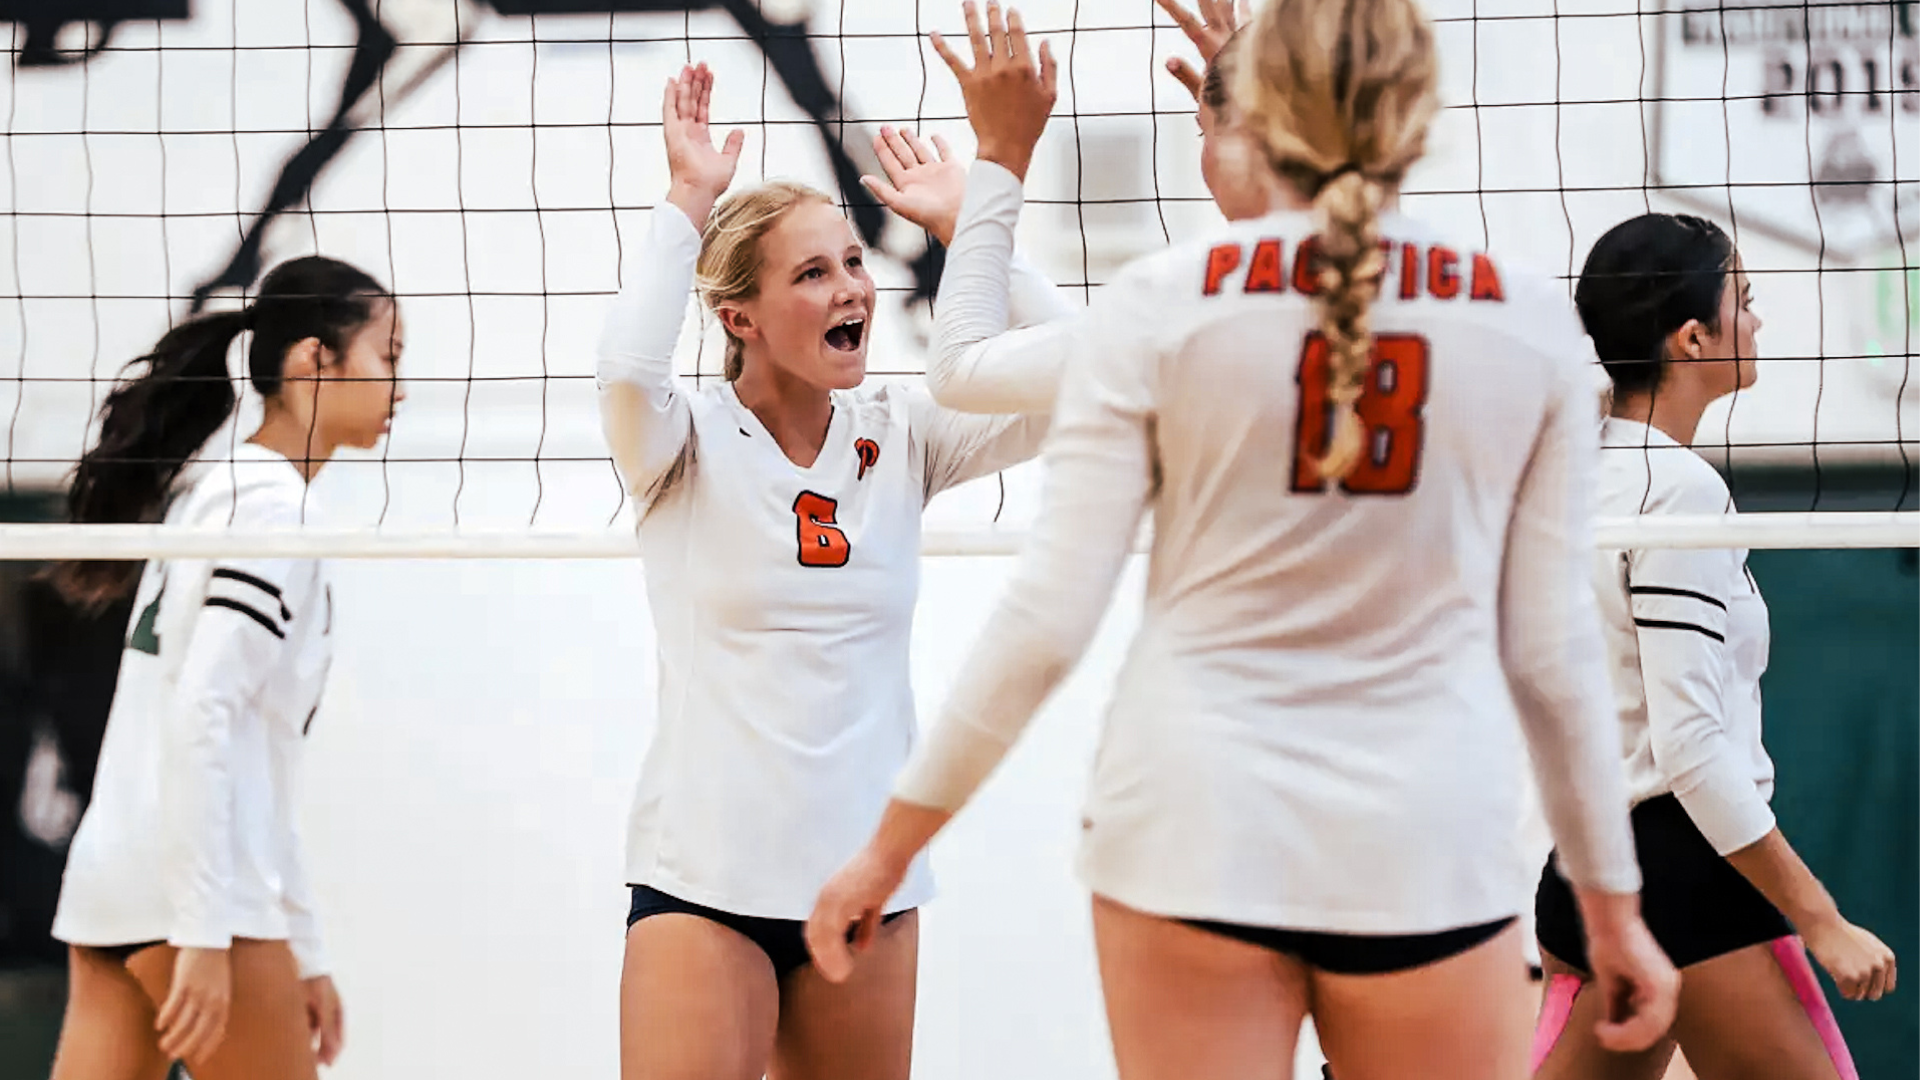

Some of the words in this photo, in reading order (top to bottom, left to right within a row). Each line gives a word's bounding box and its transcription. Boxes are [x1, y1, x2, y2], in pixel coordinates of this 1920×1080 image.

[1203, 236, 1505, 302] PACICA
[1291, 331, 1430, 495] 18
[792, 490, 850, 568] 6
